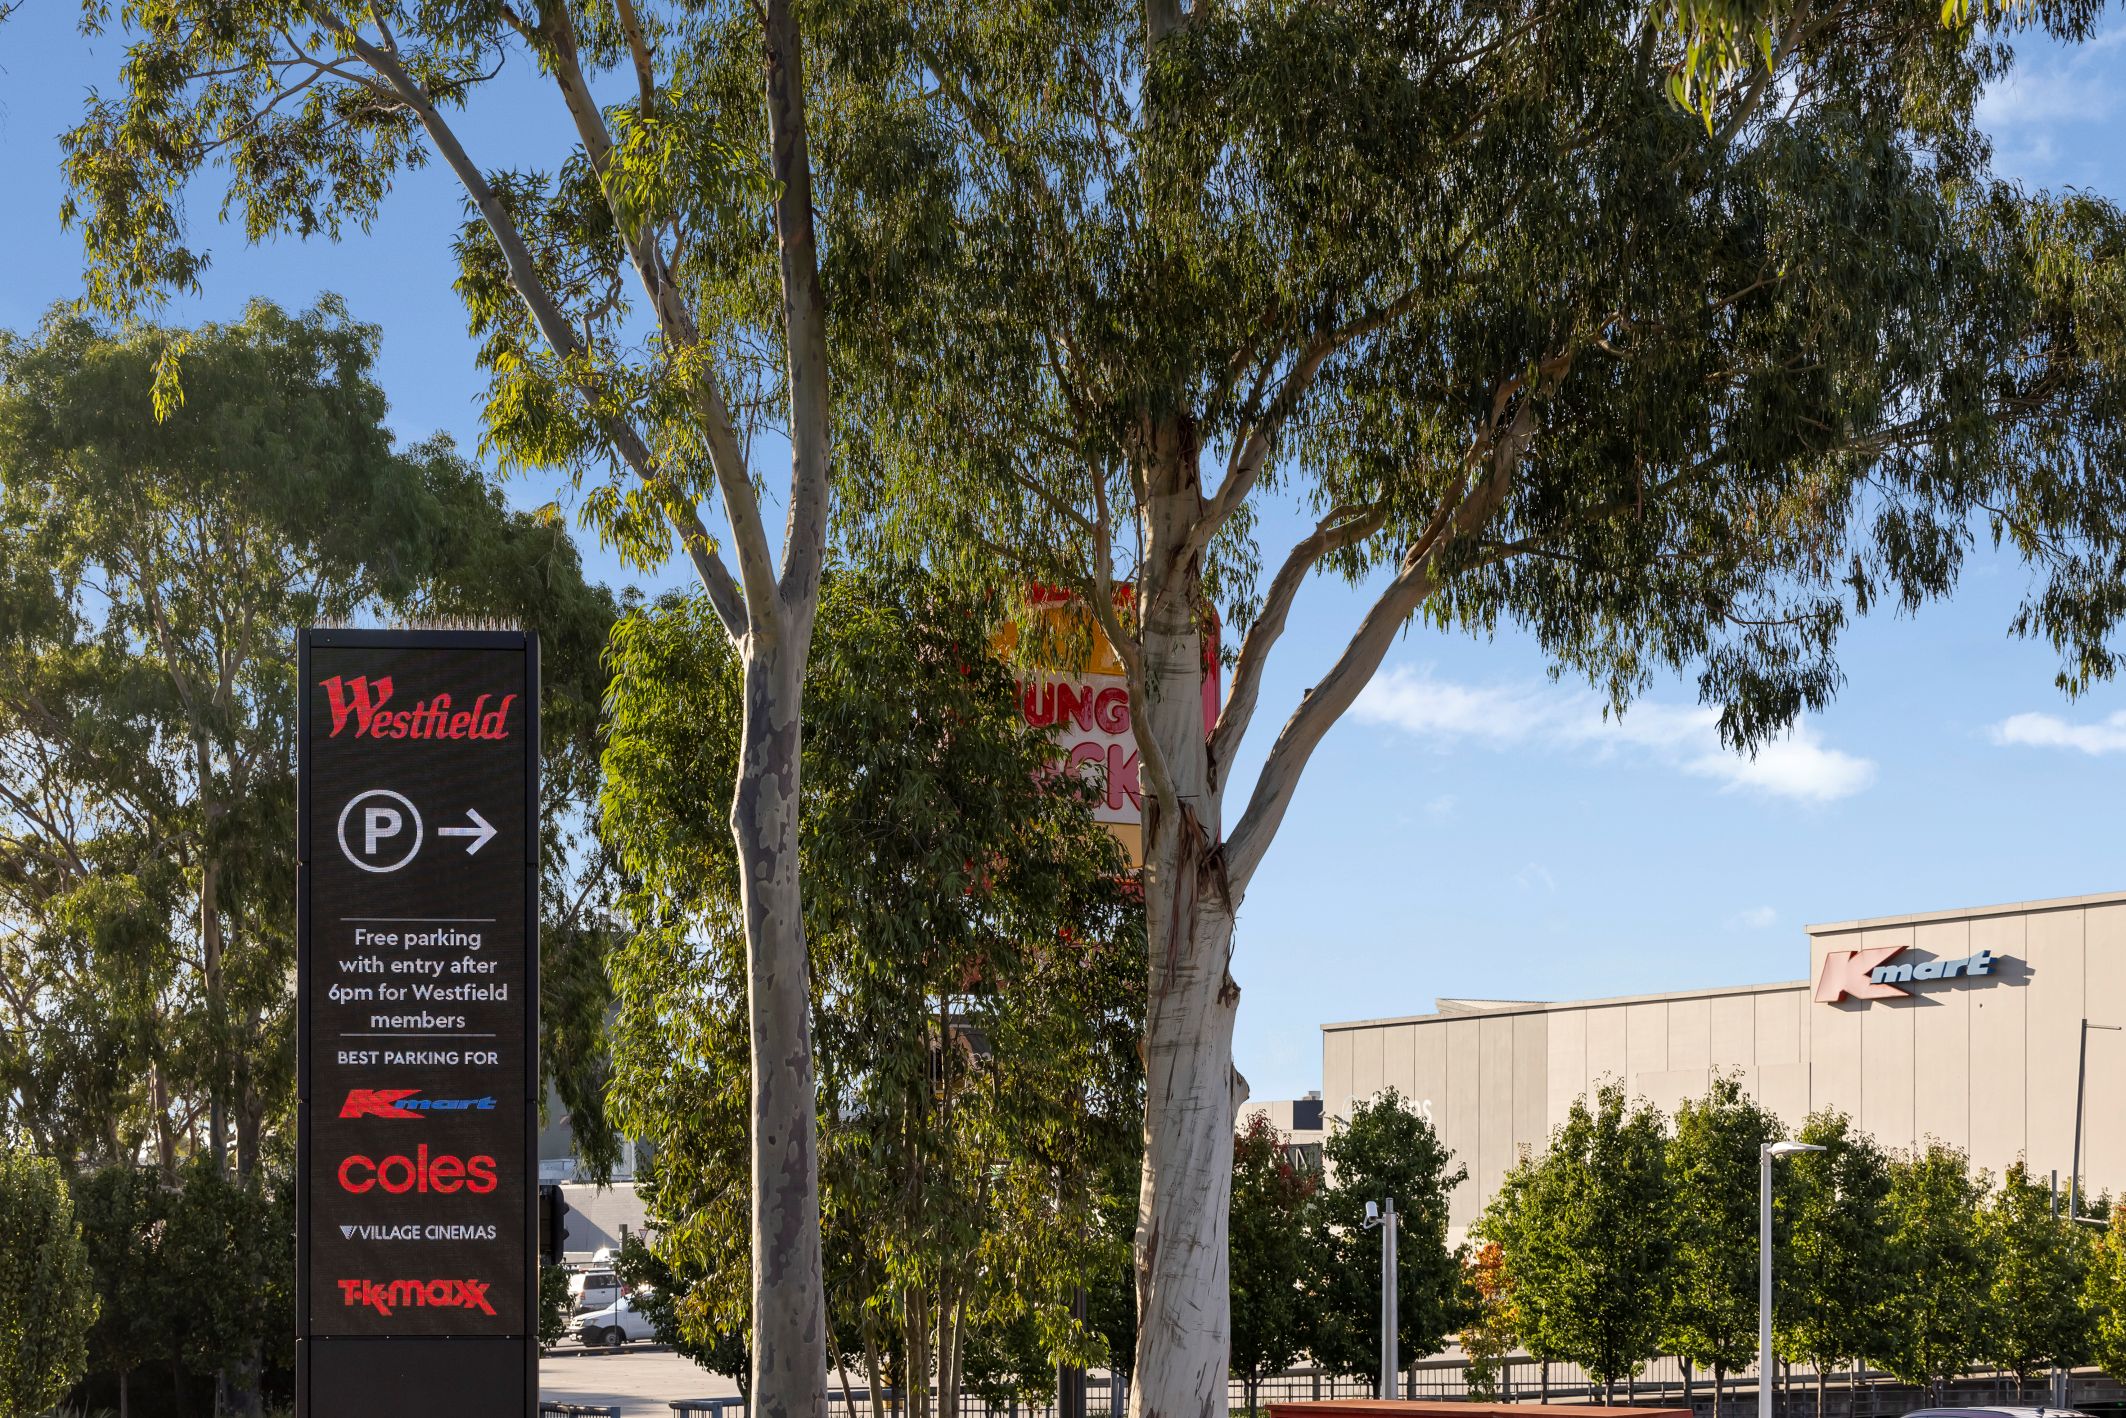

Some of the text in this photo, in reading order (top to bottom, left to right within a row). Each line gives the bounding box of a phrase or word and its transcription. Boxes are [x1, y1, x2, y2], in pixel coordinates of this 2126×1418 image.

[319, 675, 517, 739] Westfield
[366, 808, 402, 854] P
[355, 928, 481, 950] Free parking
[339, 956, 497, 978] with entry after
[1814, 945, 1998, 1003] Kmart
[328, 983, 508, 1005] 6pm for Westfield
[370, 1010, 465, 1029] members
[338, 1051, 498, 1065] BEST PARKING FOR
[339, 1089, 497, 1119] Kmart
[338, 1143, 497, 1194] coles
[359, 1225, 496, 1240] VILLAGE CINEMAS
